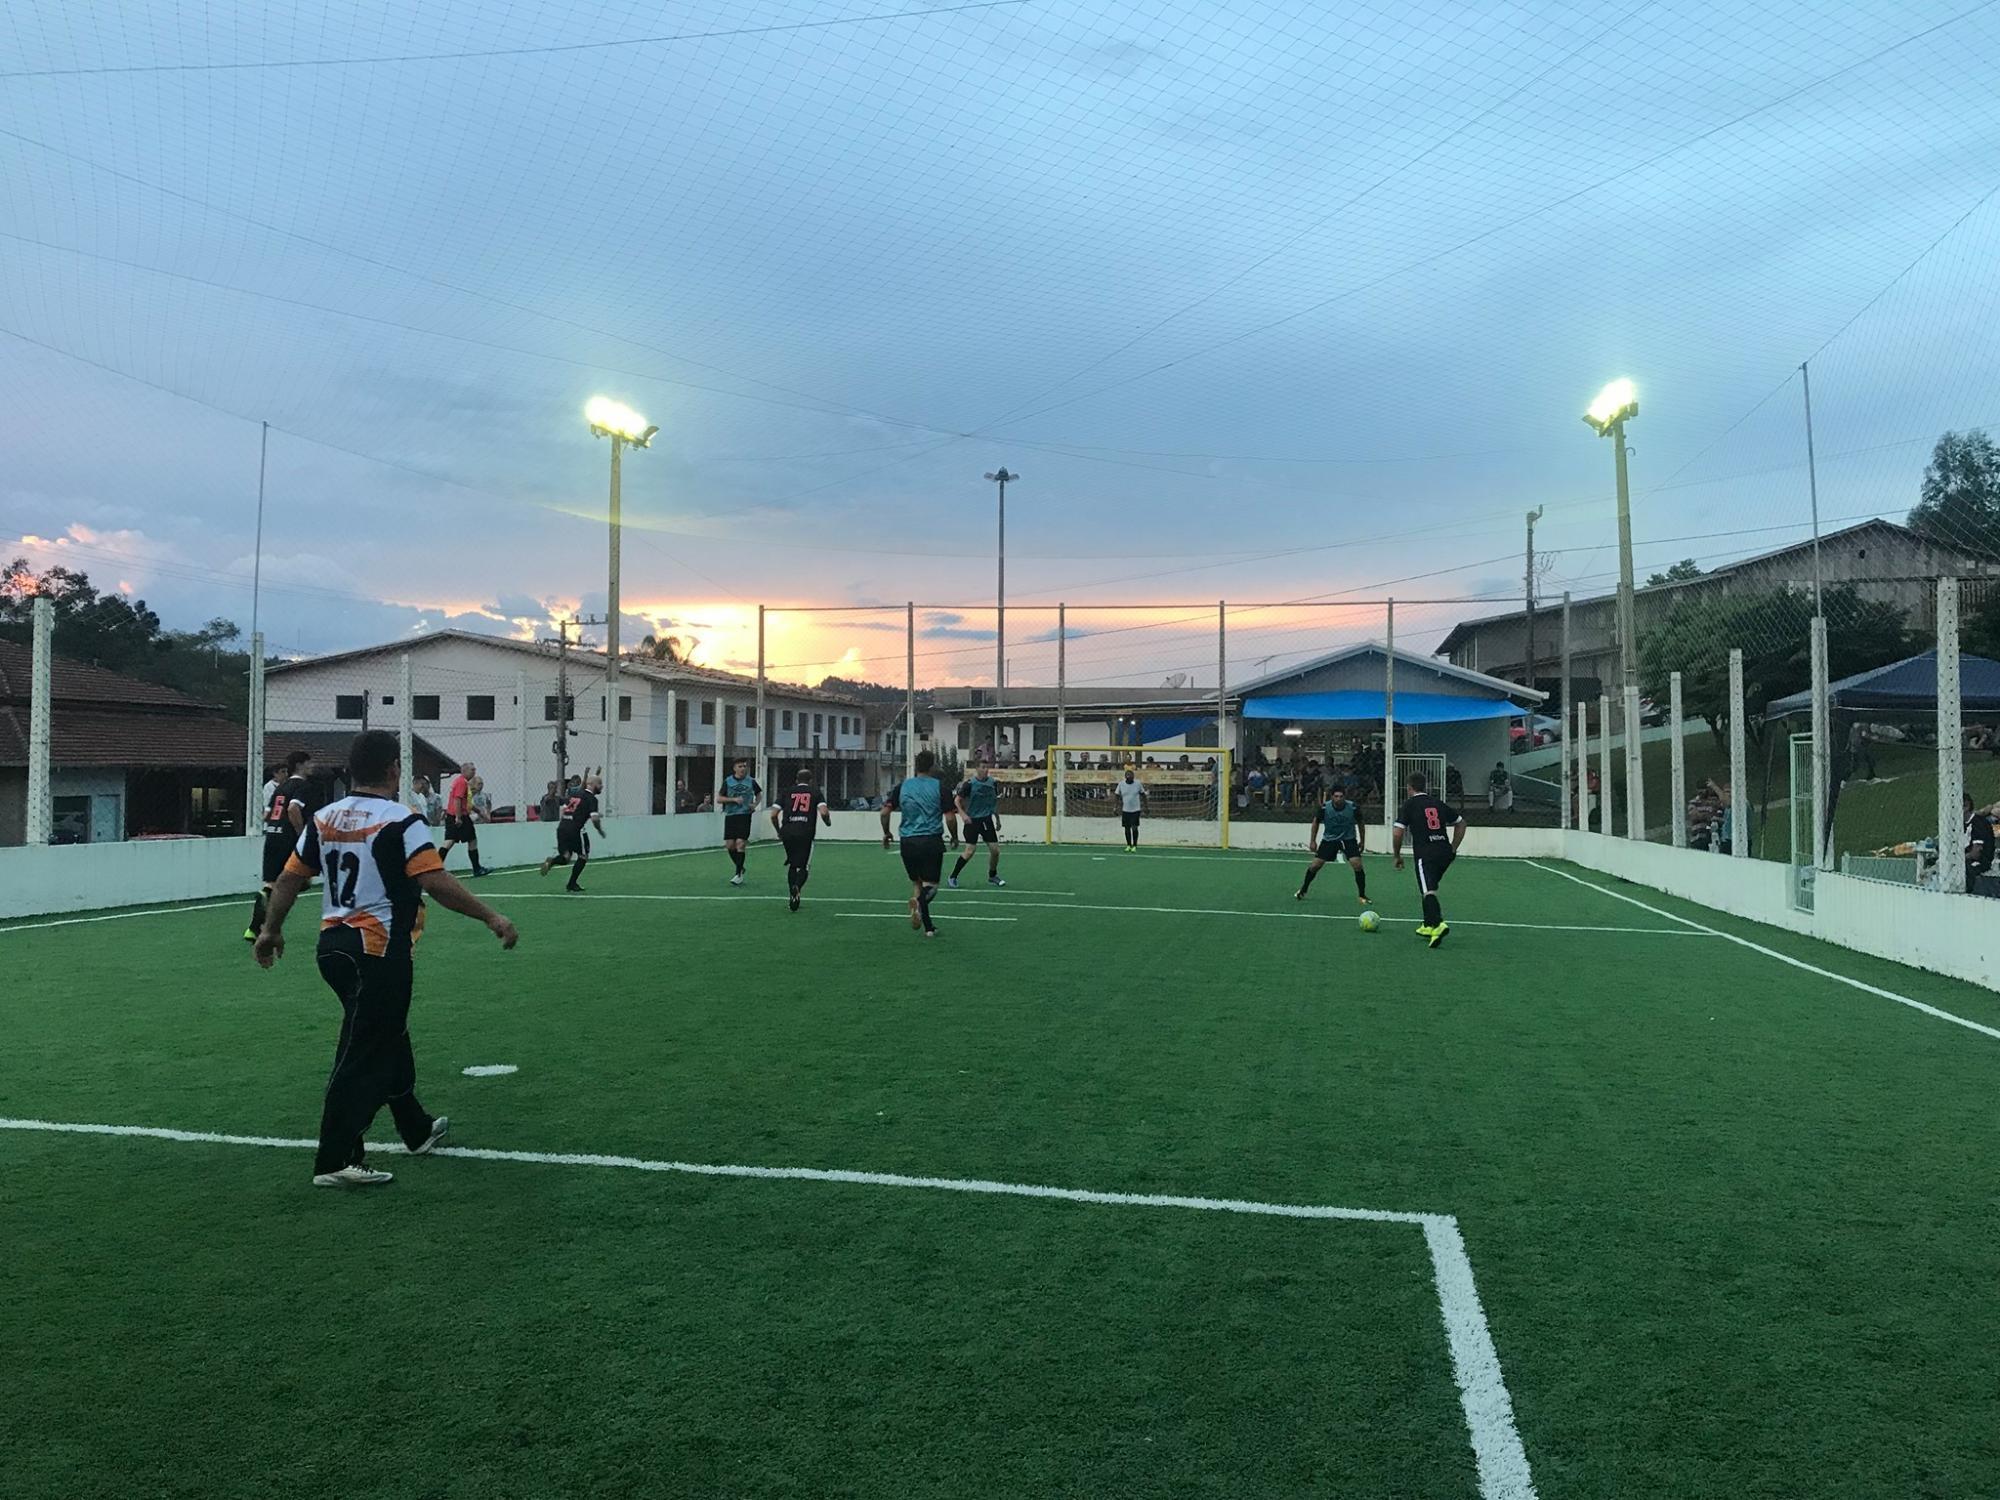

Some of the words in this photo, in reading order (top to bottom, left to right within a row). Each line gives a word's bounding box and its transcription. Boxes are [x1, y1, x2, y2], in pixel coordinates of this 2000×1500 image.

[271, 796, 285, 820] 6
[791, 793, 811, 812] 79
[1425, 807, 1440, 830] 8
[325, 849, 360, 909] 12
